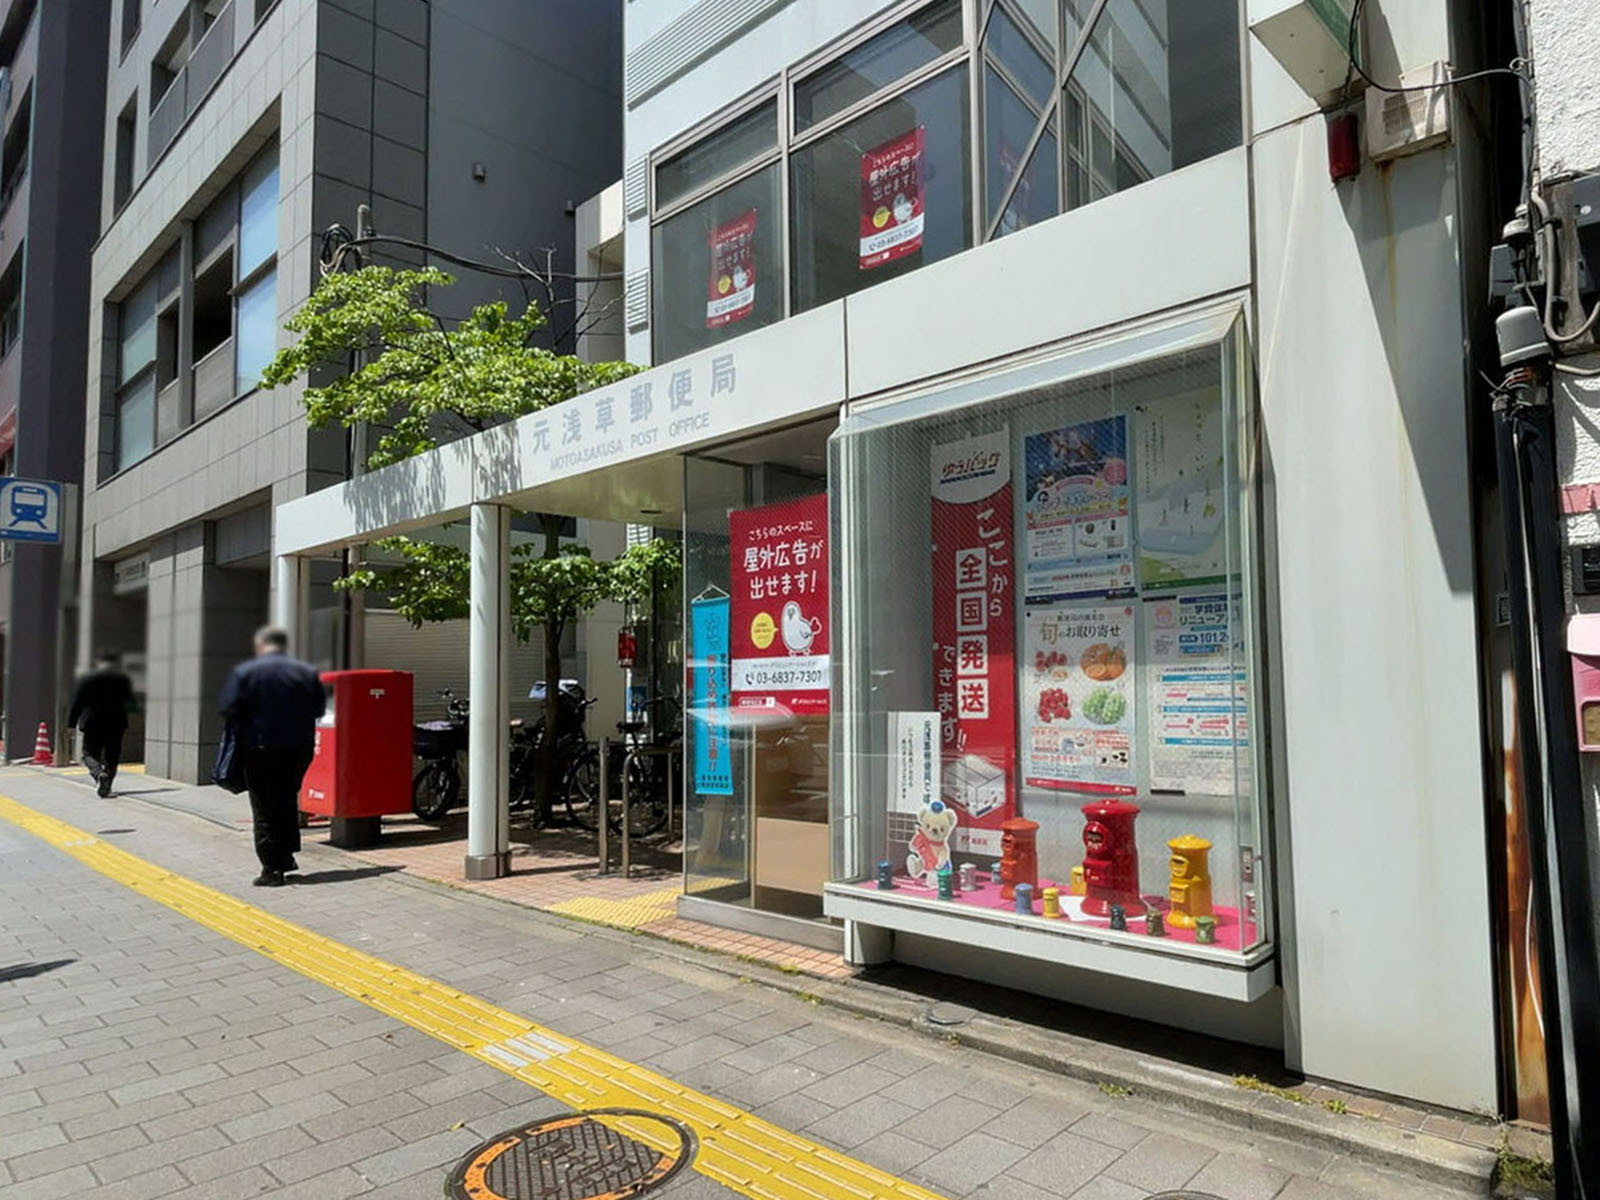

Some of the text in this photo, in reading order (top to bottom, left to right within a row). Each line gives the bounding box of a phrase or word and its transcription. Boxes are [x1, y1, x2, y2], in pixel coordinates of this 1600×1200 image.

[533, 353, 736, 454] 元浅草郵便局
[551, 412, 710, 470] MOTOASAKUSA POST OFFICE
[749, 520, 814, 541] こちらのスペースに
[744, 539, 824, 572] 屋外広告が
[976, 508, 1008, 617] ここから
[750, 569, 817, 599] 出せます!
[1179, 614, 1228, 626] リニューア
[756, 669, 822, 685] 03-6837-7307
